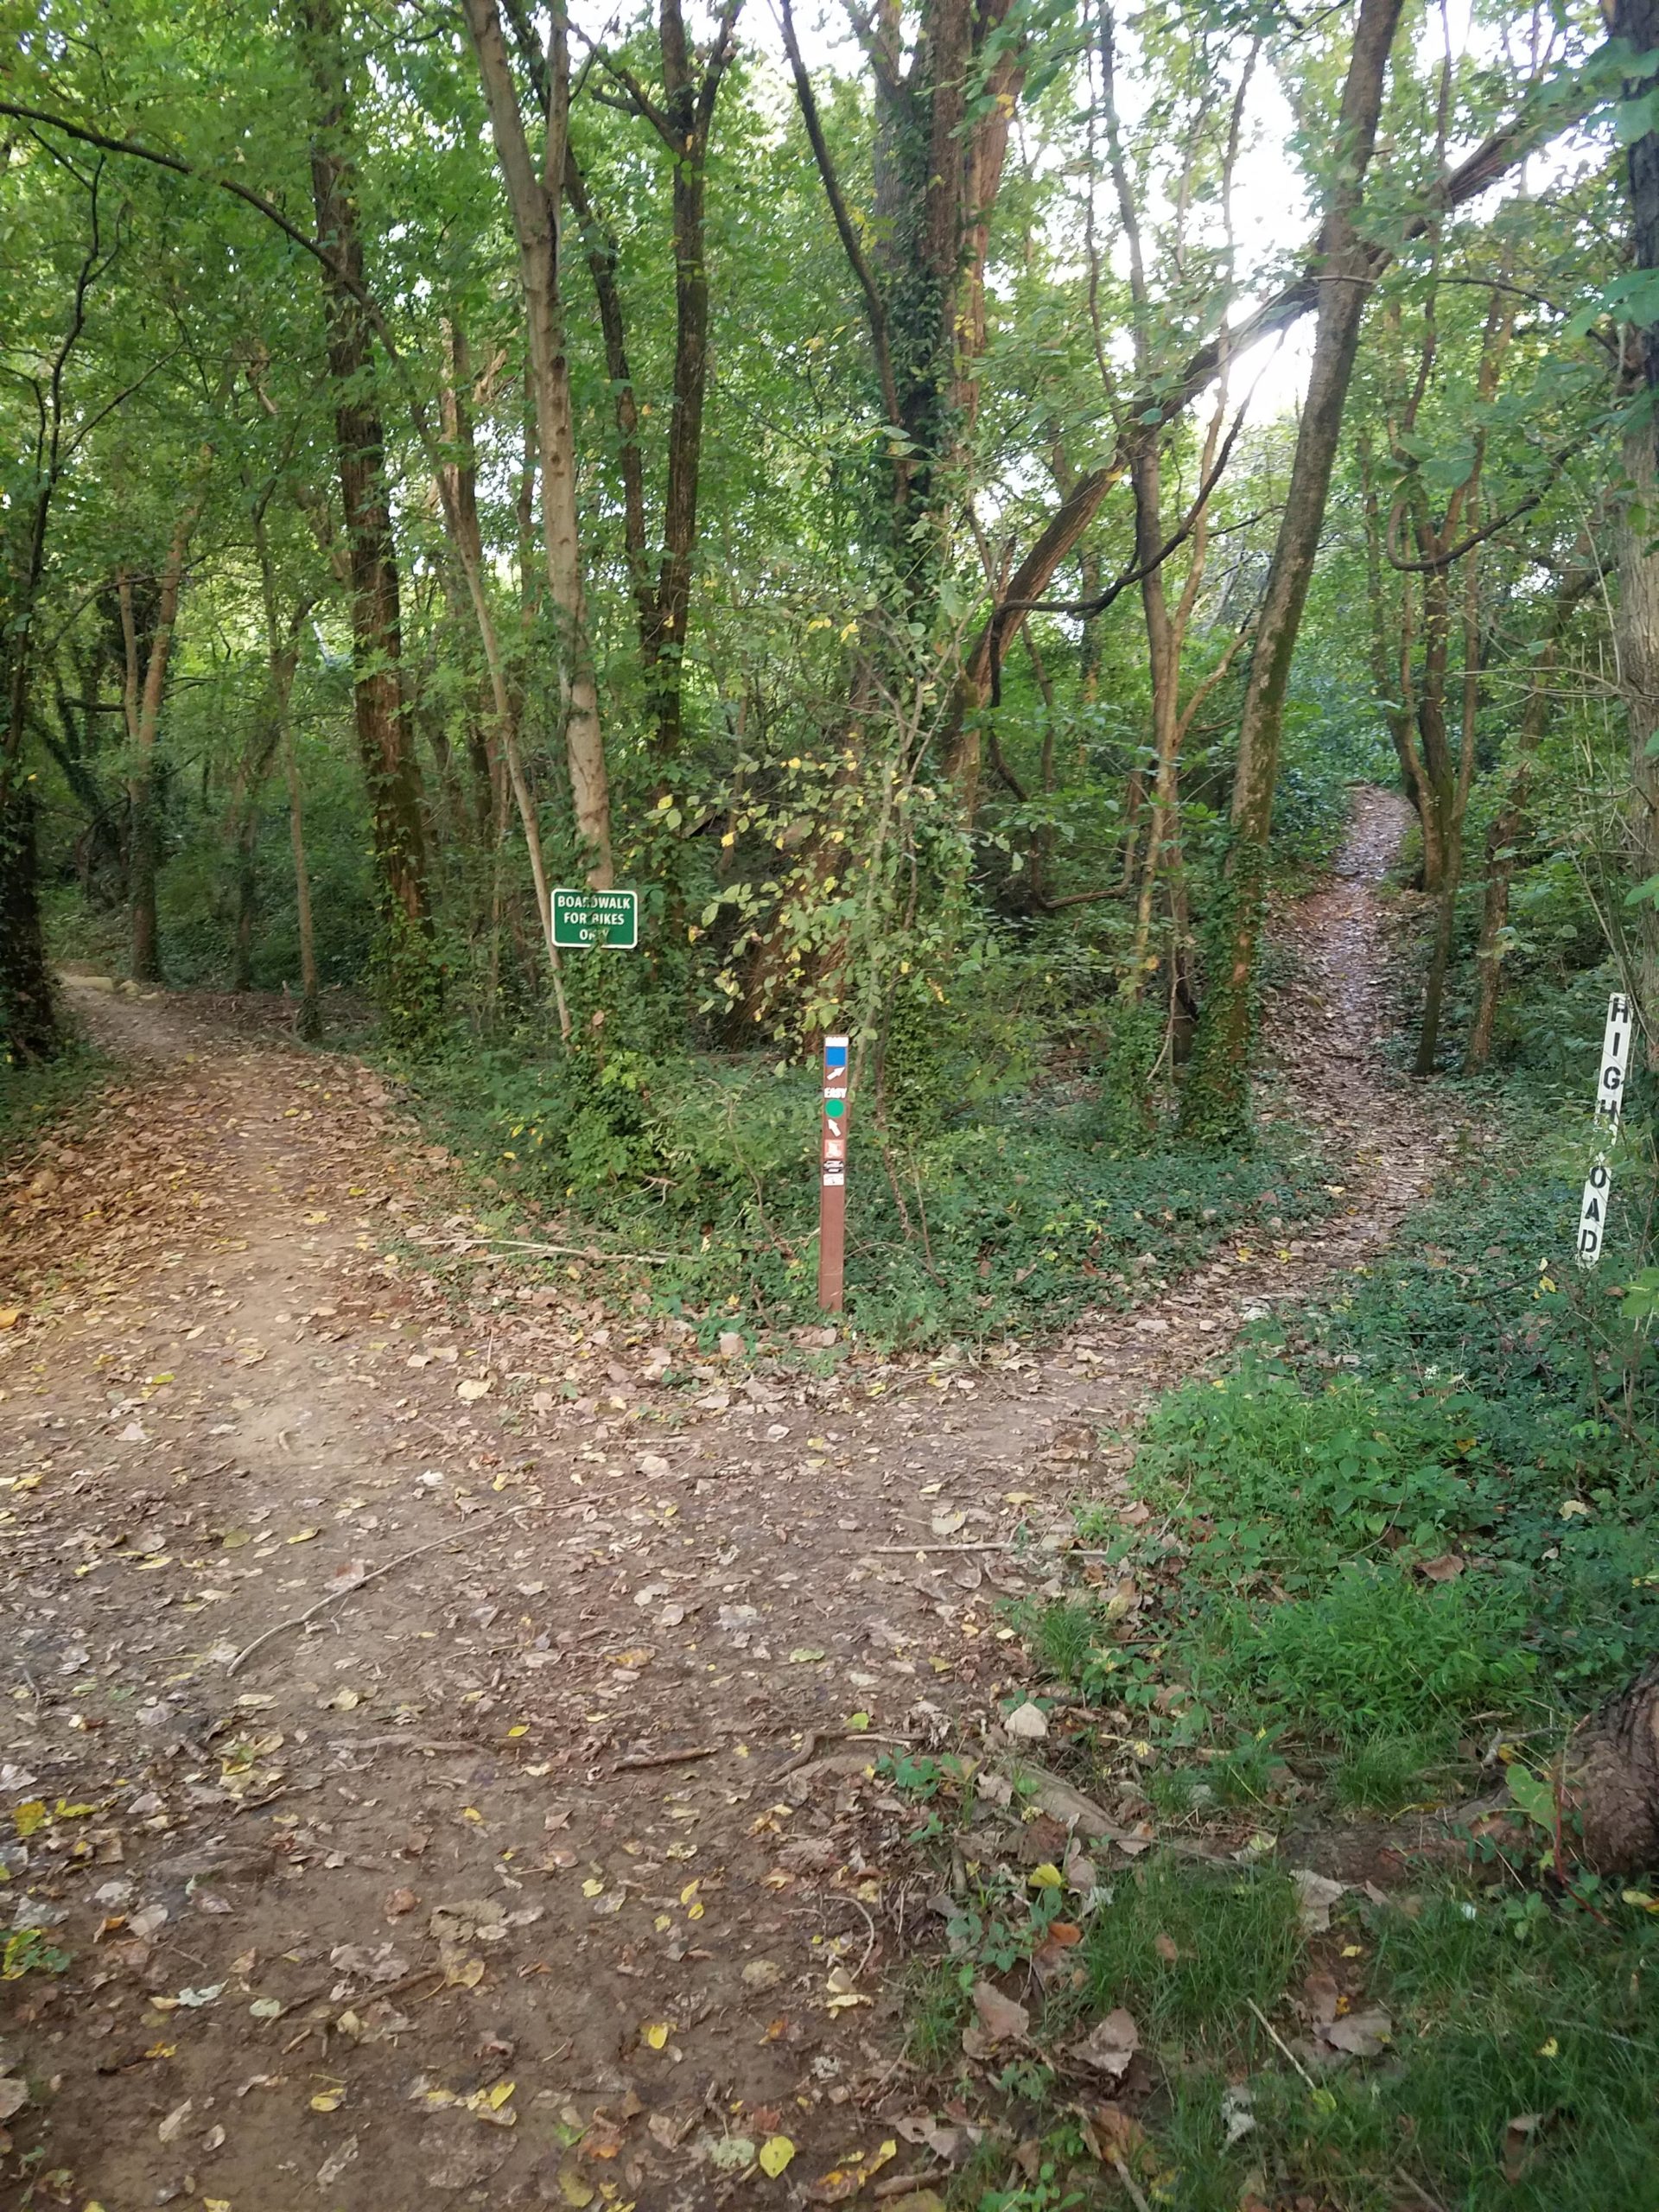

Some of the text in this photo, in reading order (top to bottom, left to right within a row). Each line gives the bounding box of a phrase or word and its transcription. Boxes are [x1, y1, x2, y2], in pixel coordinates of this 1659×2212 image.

[563, 912, 625, 925] FOR BIKES
[1580, 996, 1629, 1253] HIGH OAD
